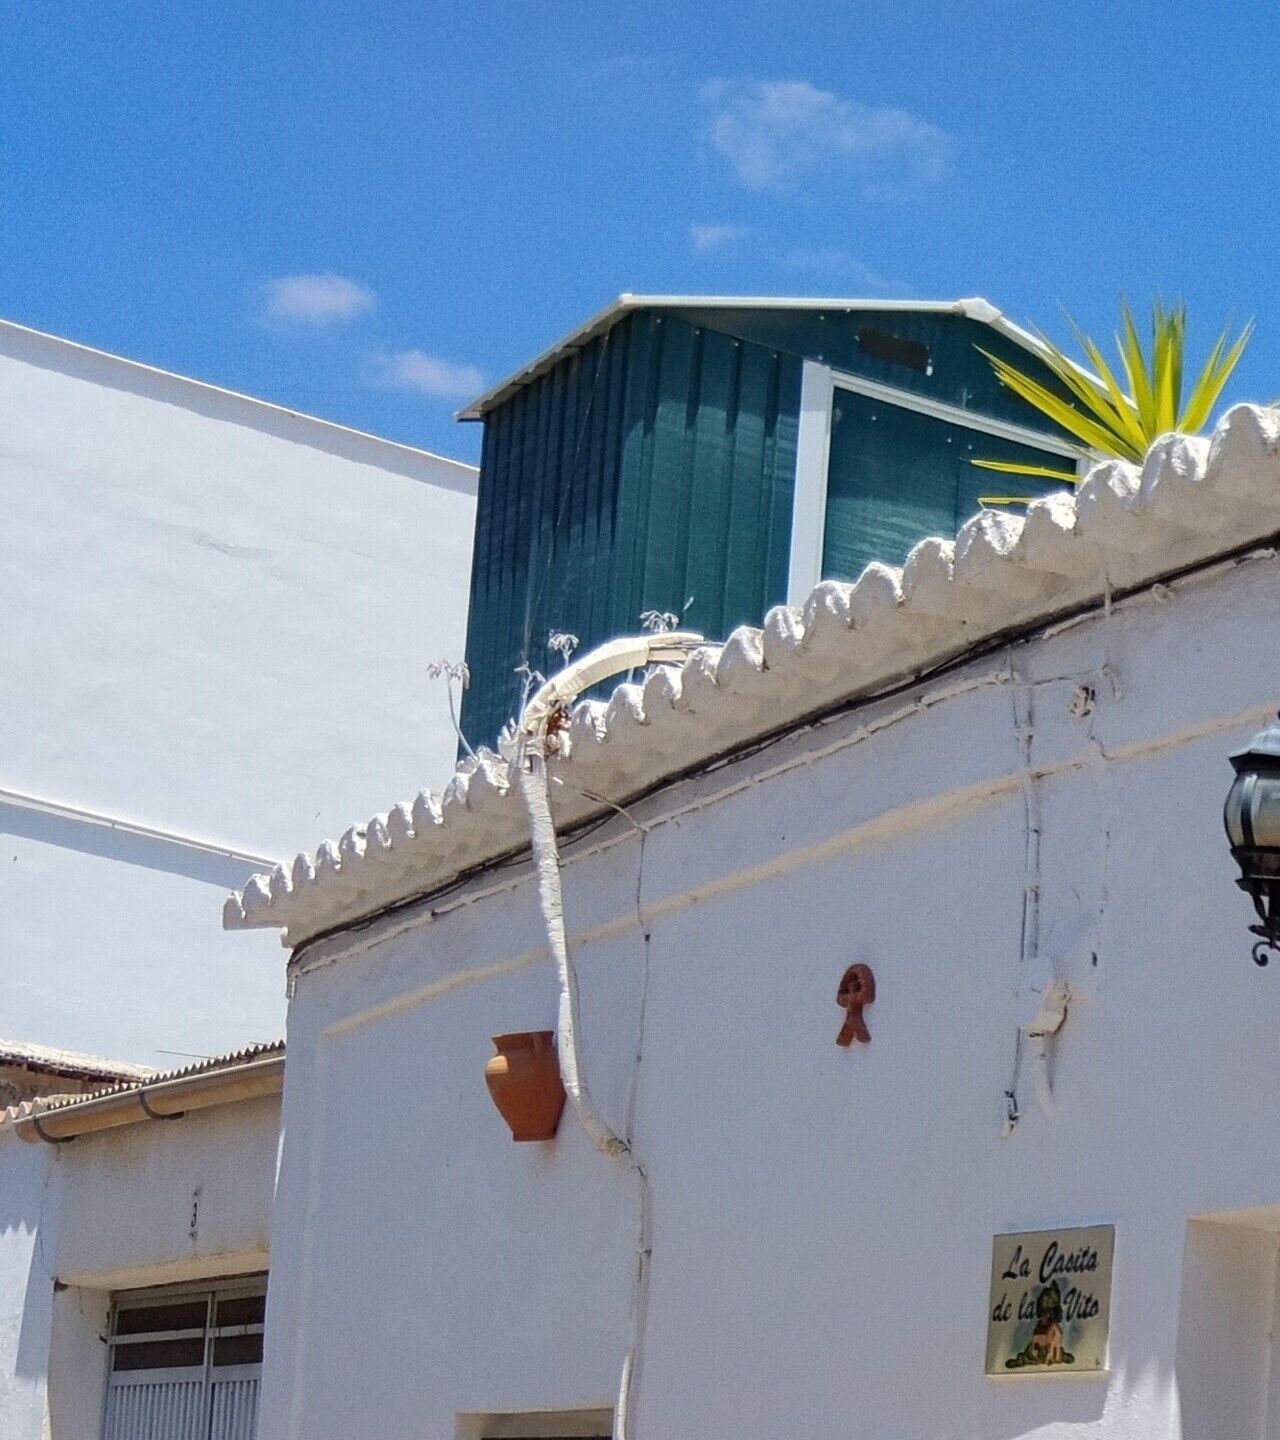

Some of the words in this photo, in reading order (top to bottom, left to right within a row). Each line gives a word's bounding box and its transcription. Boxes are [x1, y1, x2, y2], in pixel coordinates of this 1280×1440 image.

[1002, 1245, 1031, 1280] La
[1039, 1240, 1099, 1283] Casita
[992, 1293, 1012, 1322] de
[1018, 1291, 1037, 1321] la
